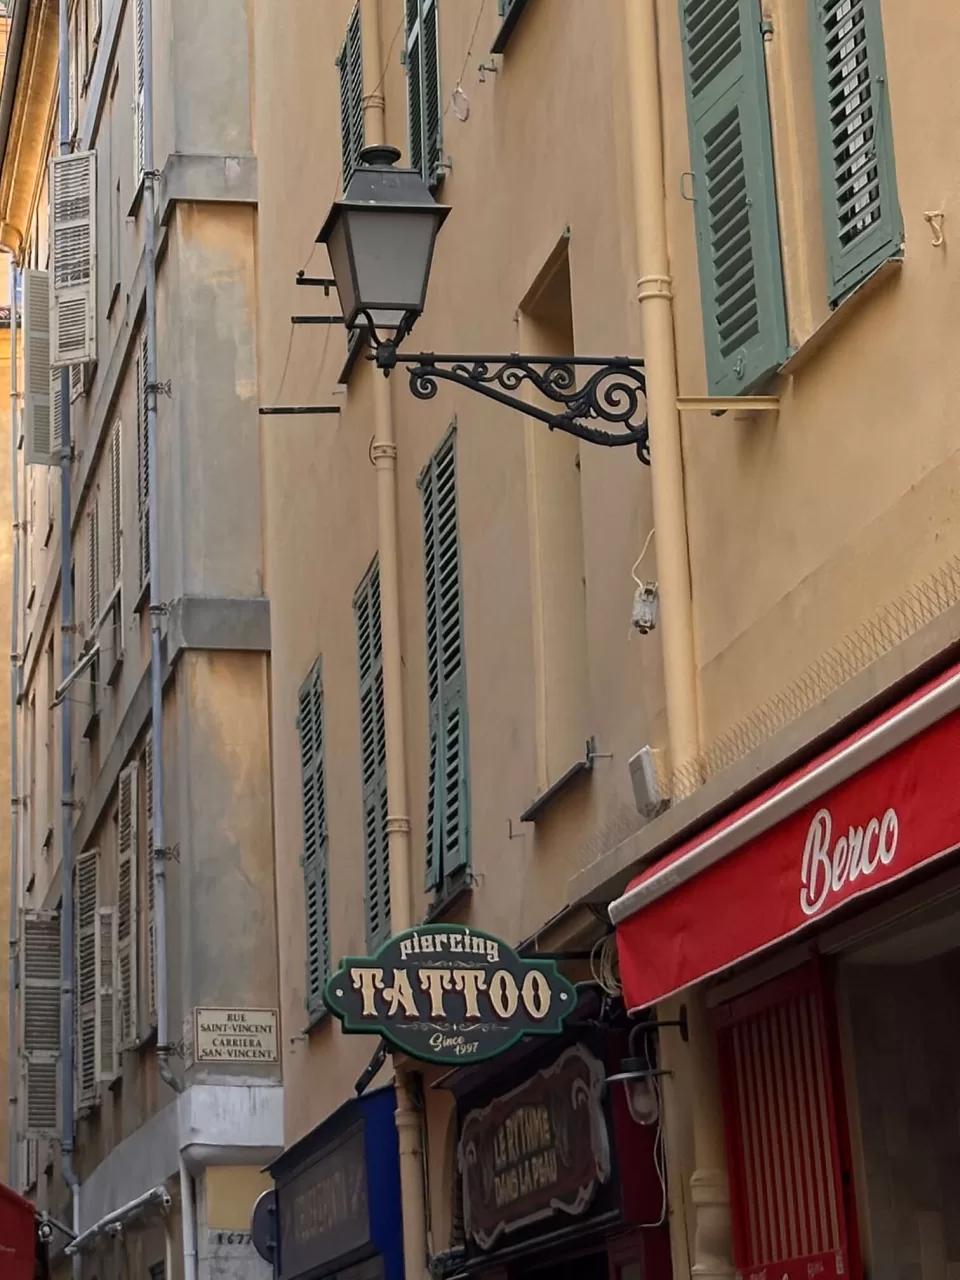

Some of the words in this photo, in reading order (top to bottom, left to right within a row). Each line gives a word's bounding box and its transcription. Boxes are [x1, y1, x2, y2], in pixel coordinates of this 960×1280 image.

[801, 807, 898, 915] Berco
[399, 928, 499, 962] piercing
[351, 968, 551, 1018] TATTOO
[226, 1013, 246, 1022] RUE
[200, 1023, 273, 1034] SAINT-VINCENT
[212, 1038, 262, 1048] CARRIERA
[429, 1032, 465, 1051] Since
[453, 1041, 479, 1055] 1997
[202, 1048, 273, 1059] SAN-VINCENT
